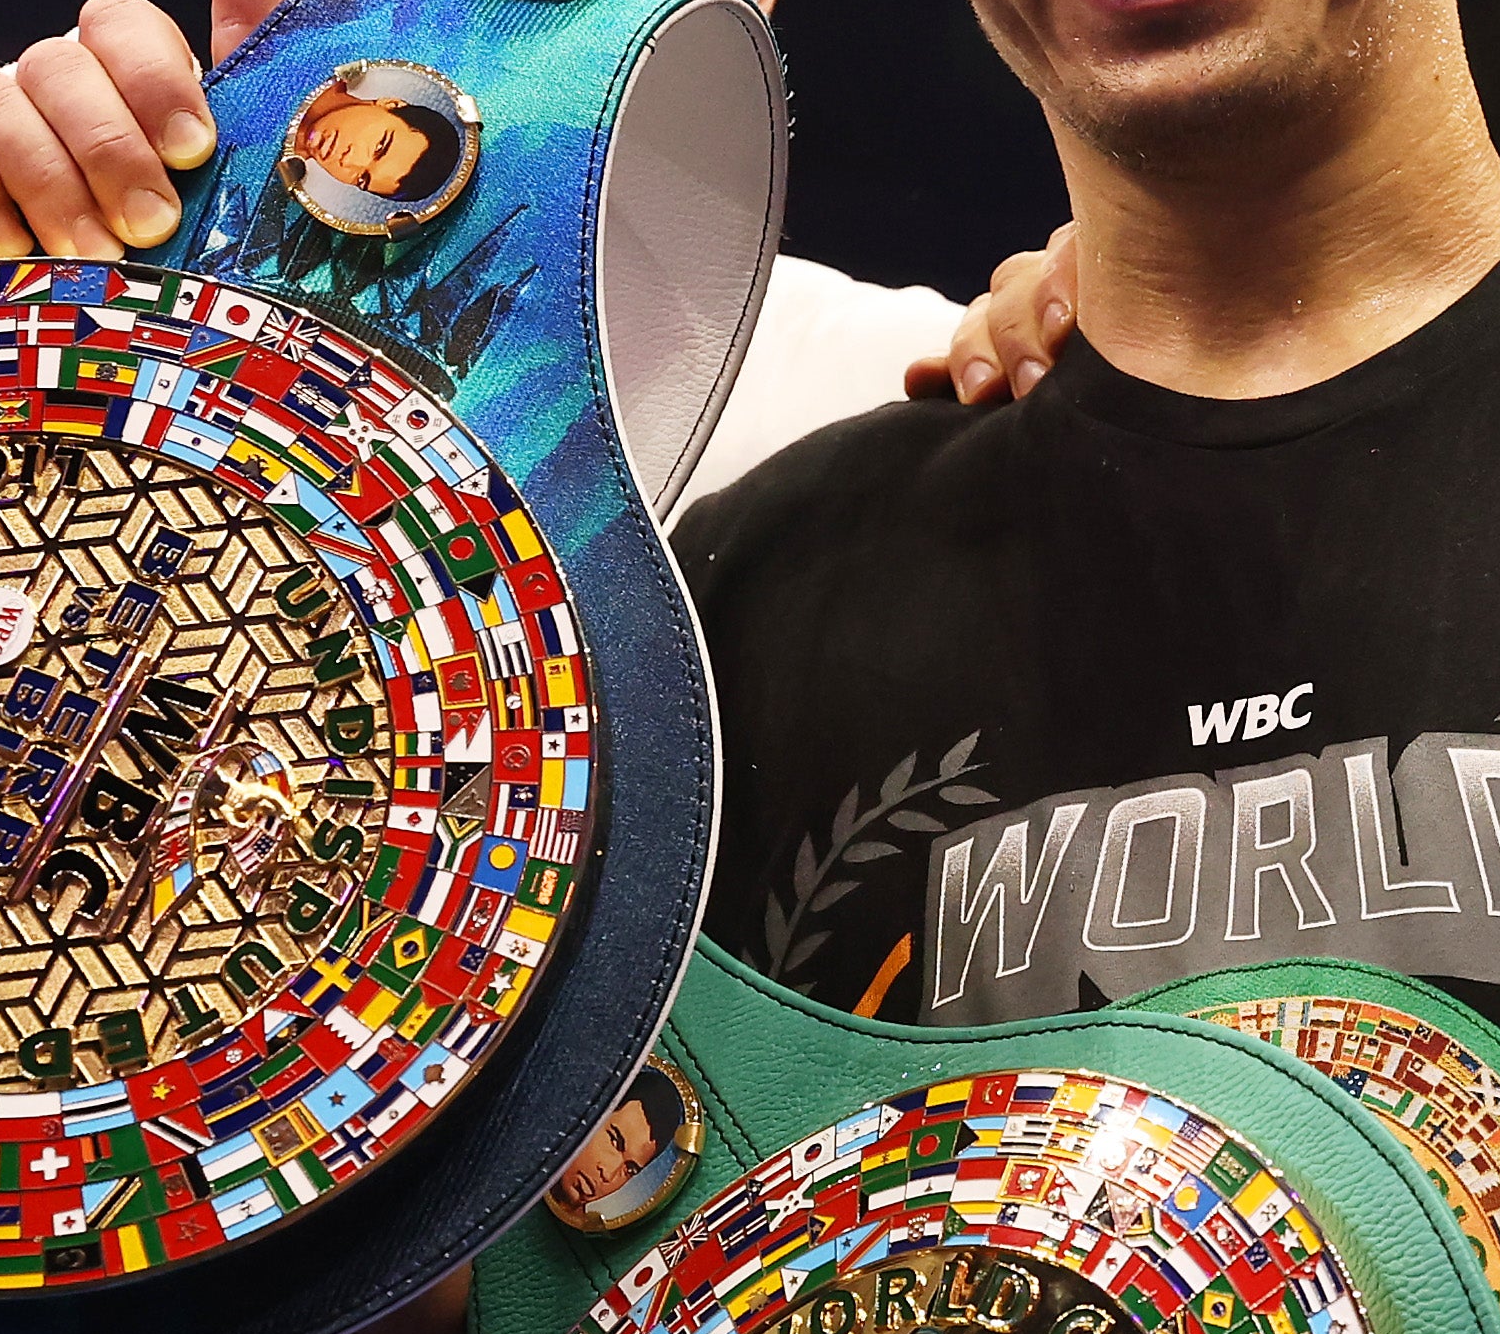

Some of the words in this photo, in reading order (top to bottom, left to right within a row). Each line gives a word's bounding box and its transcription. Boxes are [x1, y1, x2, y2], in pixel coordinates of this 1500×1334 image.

[19, 563, 376, 1081] UNDISPUTED
[36, 673, 222, 921] WBC
[1187, 682, 1315, 747] WBC
